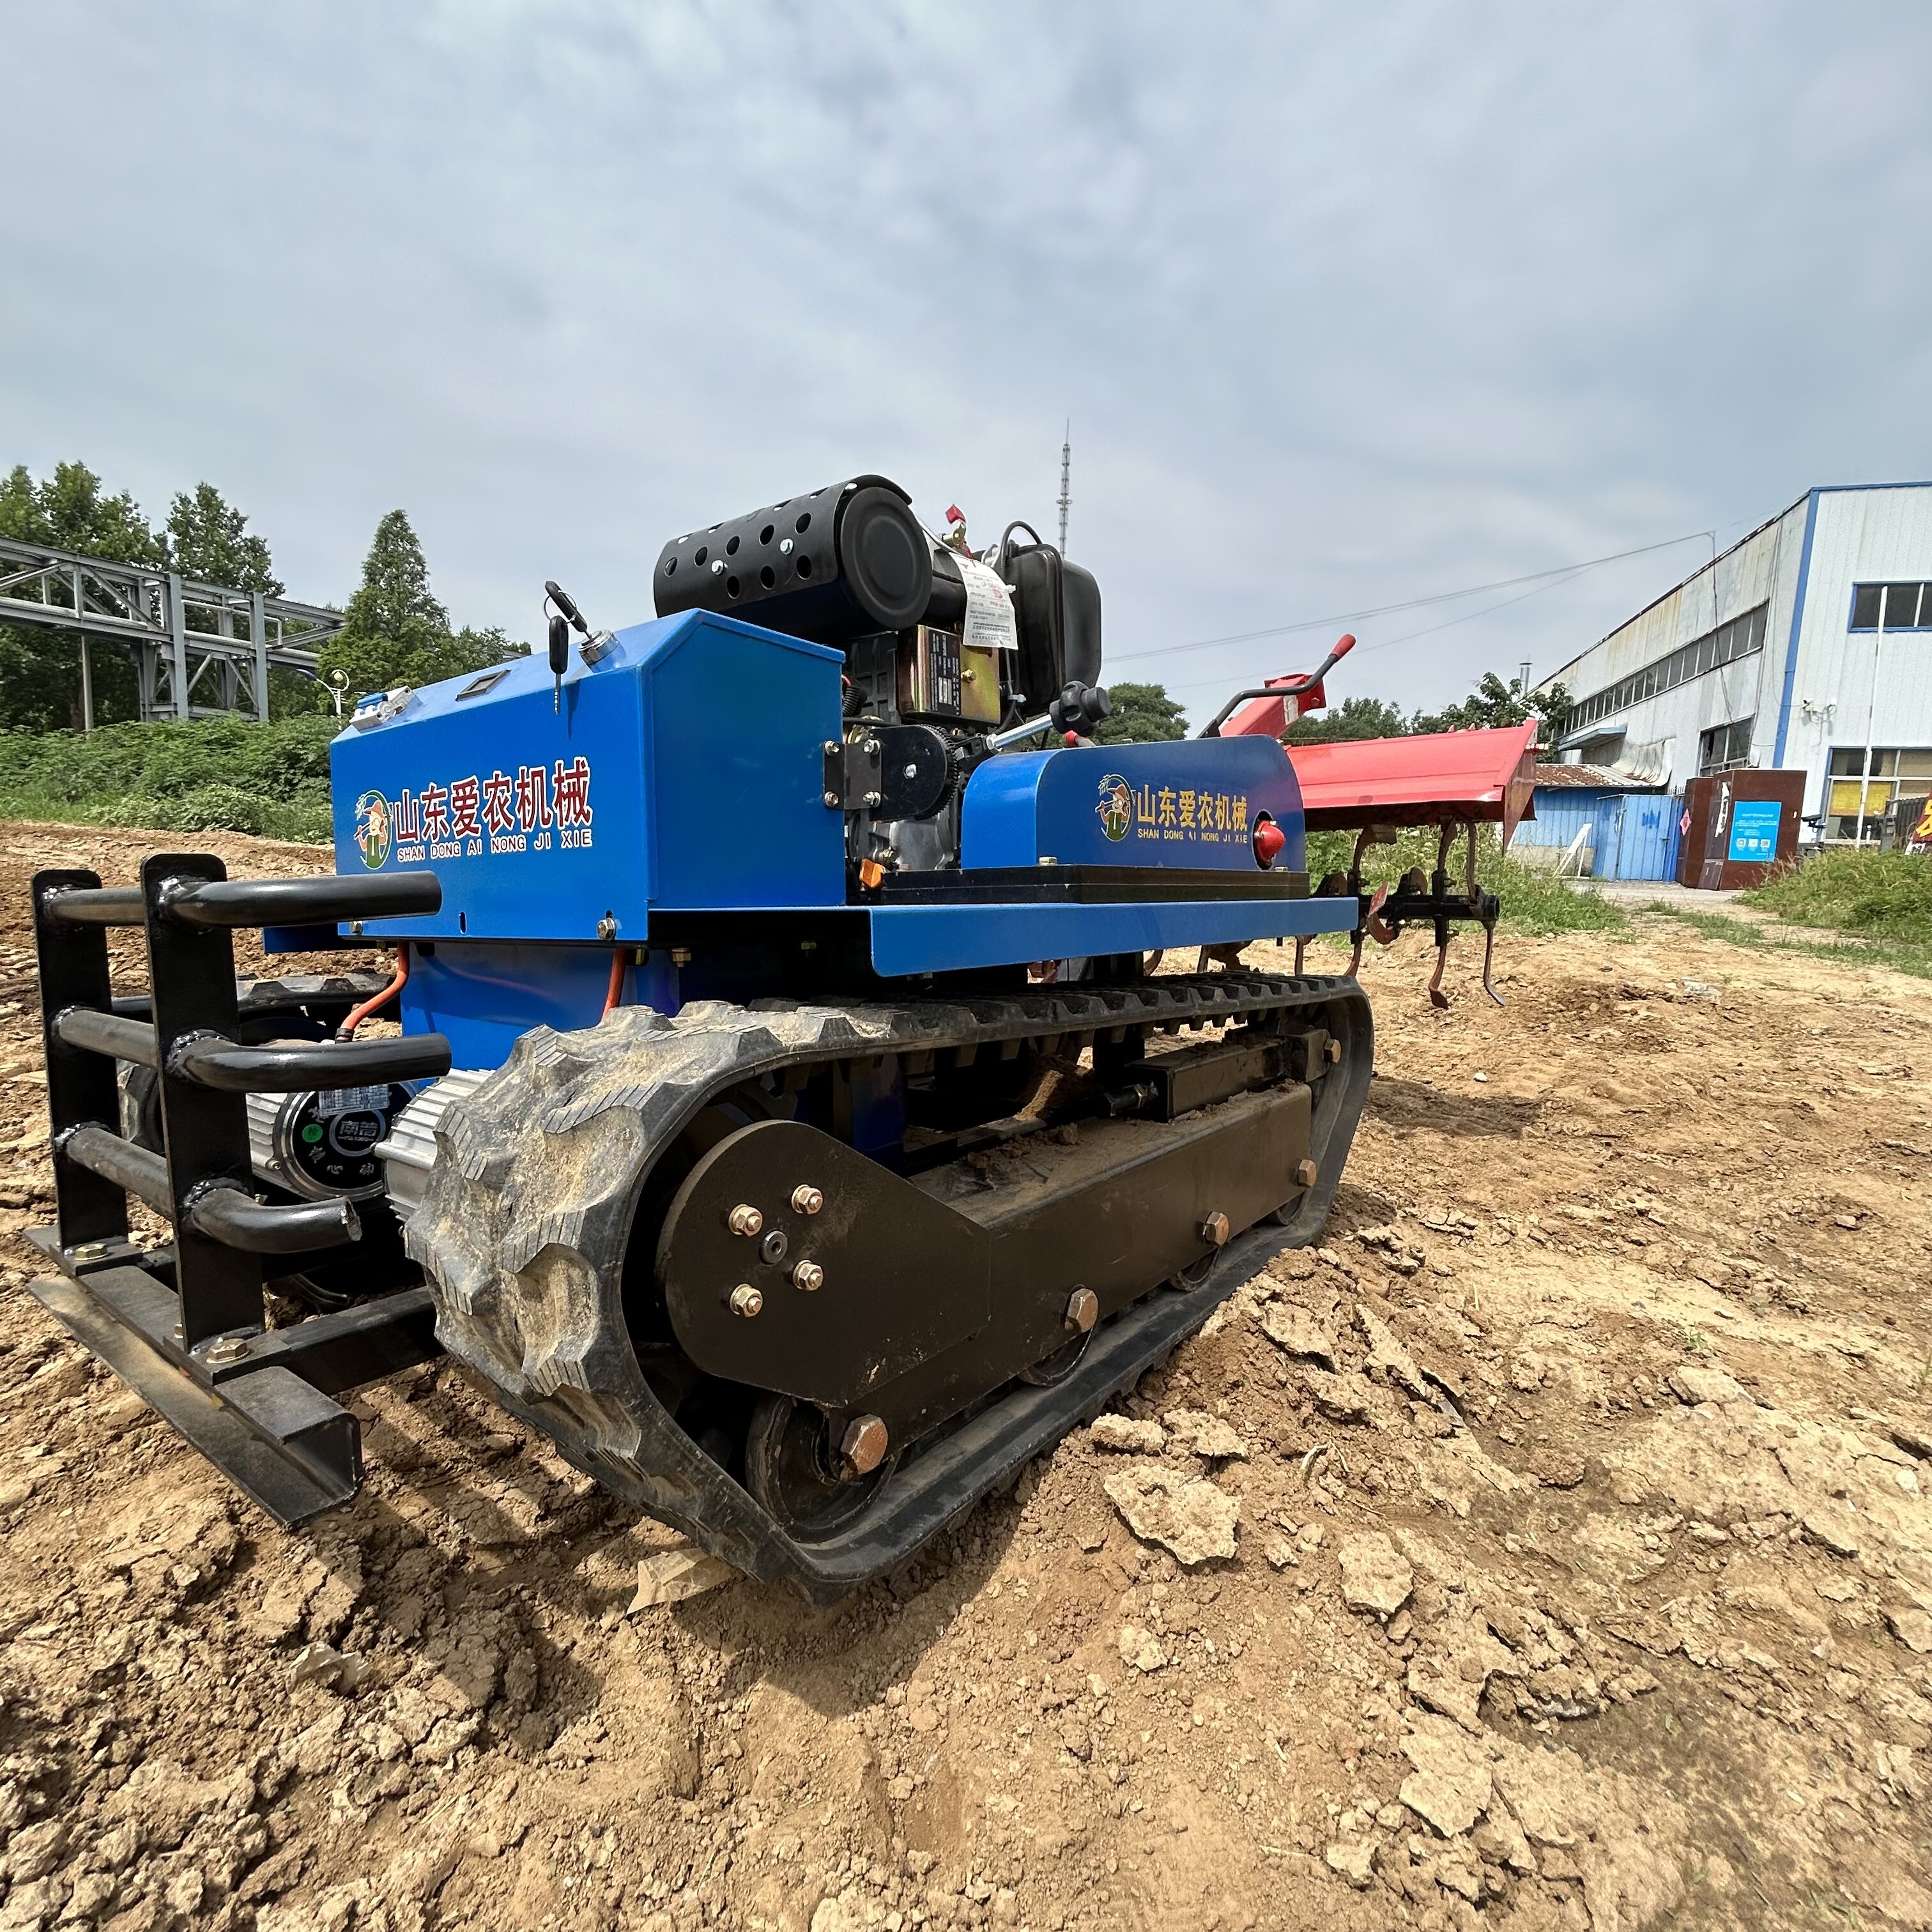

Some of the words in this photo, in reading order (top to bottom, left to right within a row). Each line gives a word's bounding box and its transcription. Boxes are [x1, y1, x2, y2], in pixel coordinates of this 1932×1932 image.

[395, 756, 592, 843] 山东爱农机械
[1137, 784, 1248, 832] 山东爱农机械
[397, 845, 425, 862] SHAN
[431, 841, 461, 859] DONG
[467, 839, 482, 855] AI
[491, 834, 526, 854] NONG
[534, 832, 551, 850] JI
[561, 829, 592, 848] XIE
[1137, 828, 1160, 839] SHAN
[1163, 830, 1184, 840] DONG
[1201, 832, 1219, 842] NONG
[1223, 833, 1230, 842] JI
[1234, 834, 1248, 843] XIE
